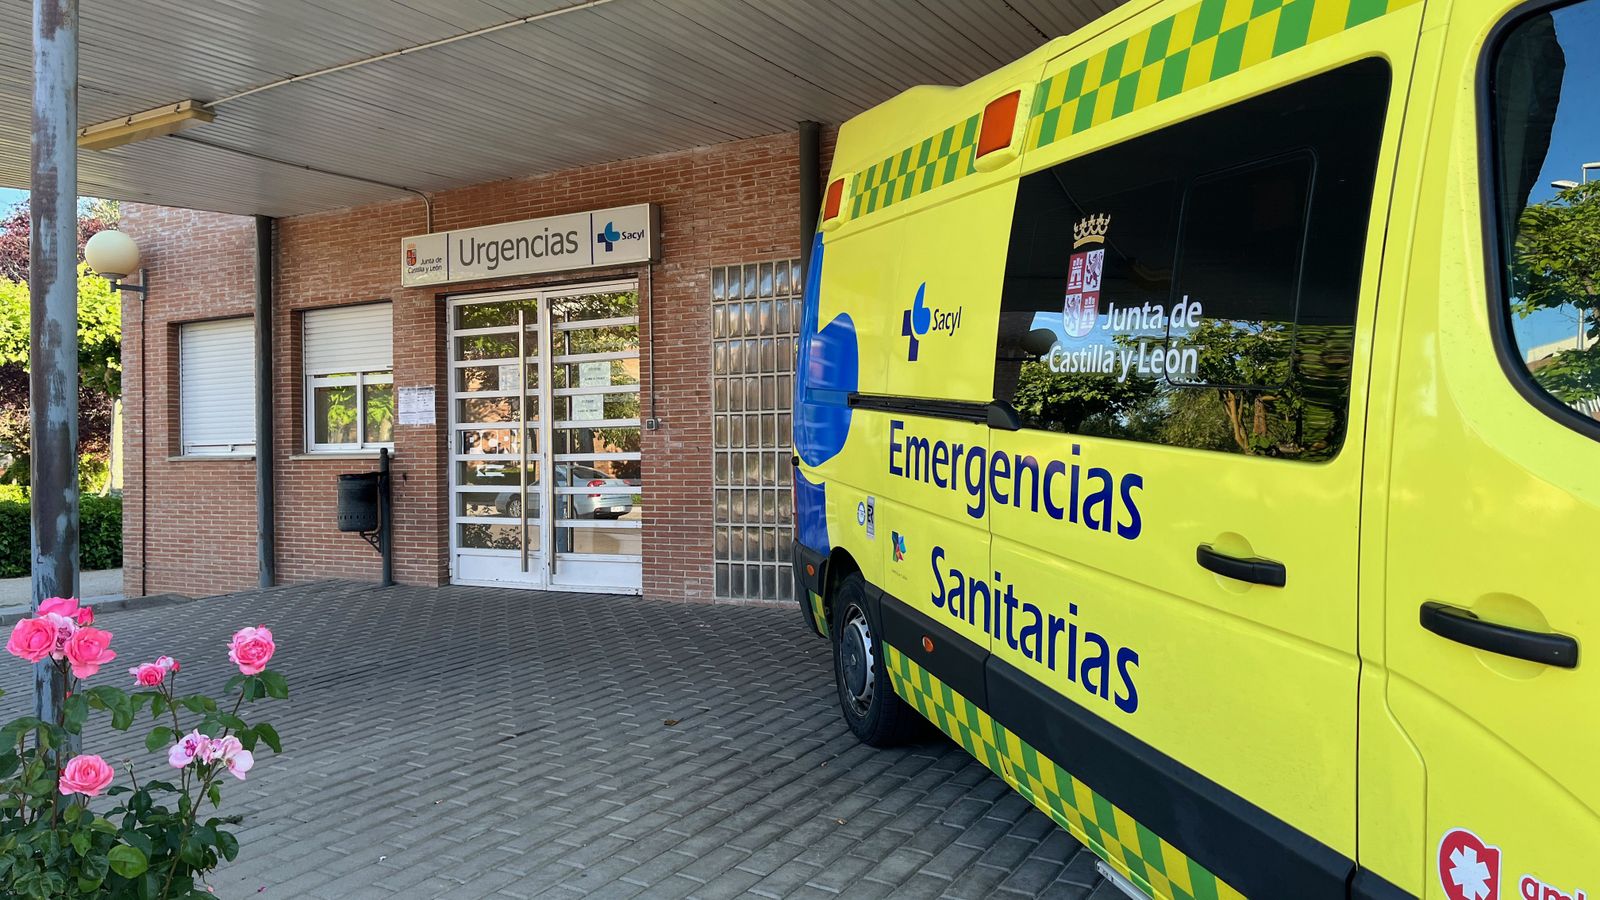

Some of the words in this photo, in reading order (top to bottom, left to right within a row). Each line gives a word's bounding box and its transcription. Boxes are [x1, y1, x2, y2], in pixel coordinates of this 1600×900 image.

[459, 227, 579, 271] Urgencias
[621, 229, 645, 241] Sacyl
[420, 257, 435, 265] Junta
[932, 305, 962, 337] Sacyl
[1102, 301, 1164, 331] Junta
[1170, 295, 1203, 329] de
[1049, 344, 1114, 374] Castilla
[1117, 349, 1134, 384] y
[1137, 340, 1198, 374] León
[889, 419, 1144, 541] Emergencias
[931, 545, 1140, 714] Sanitarias
